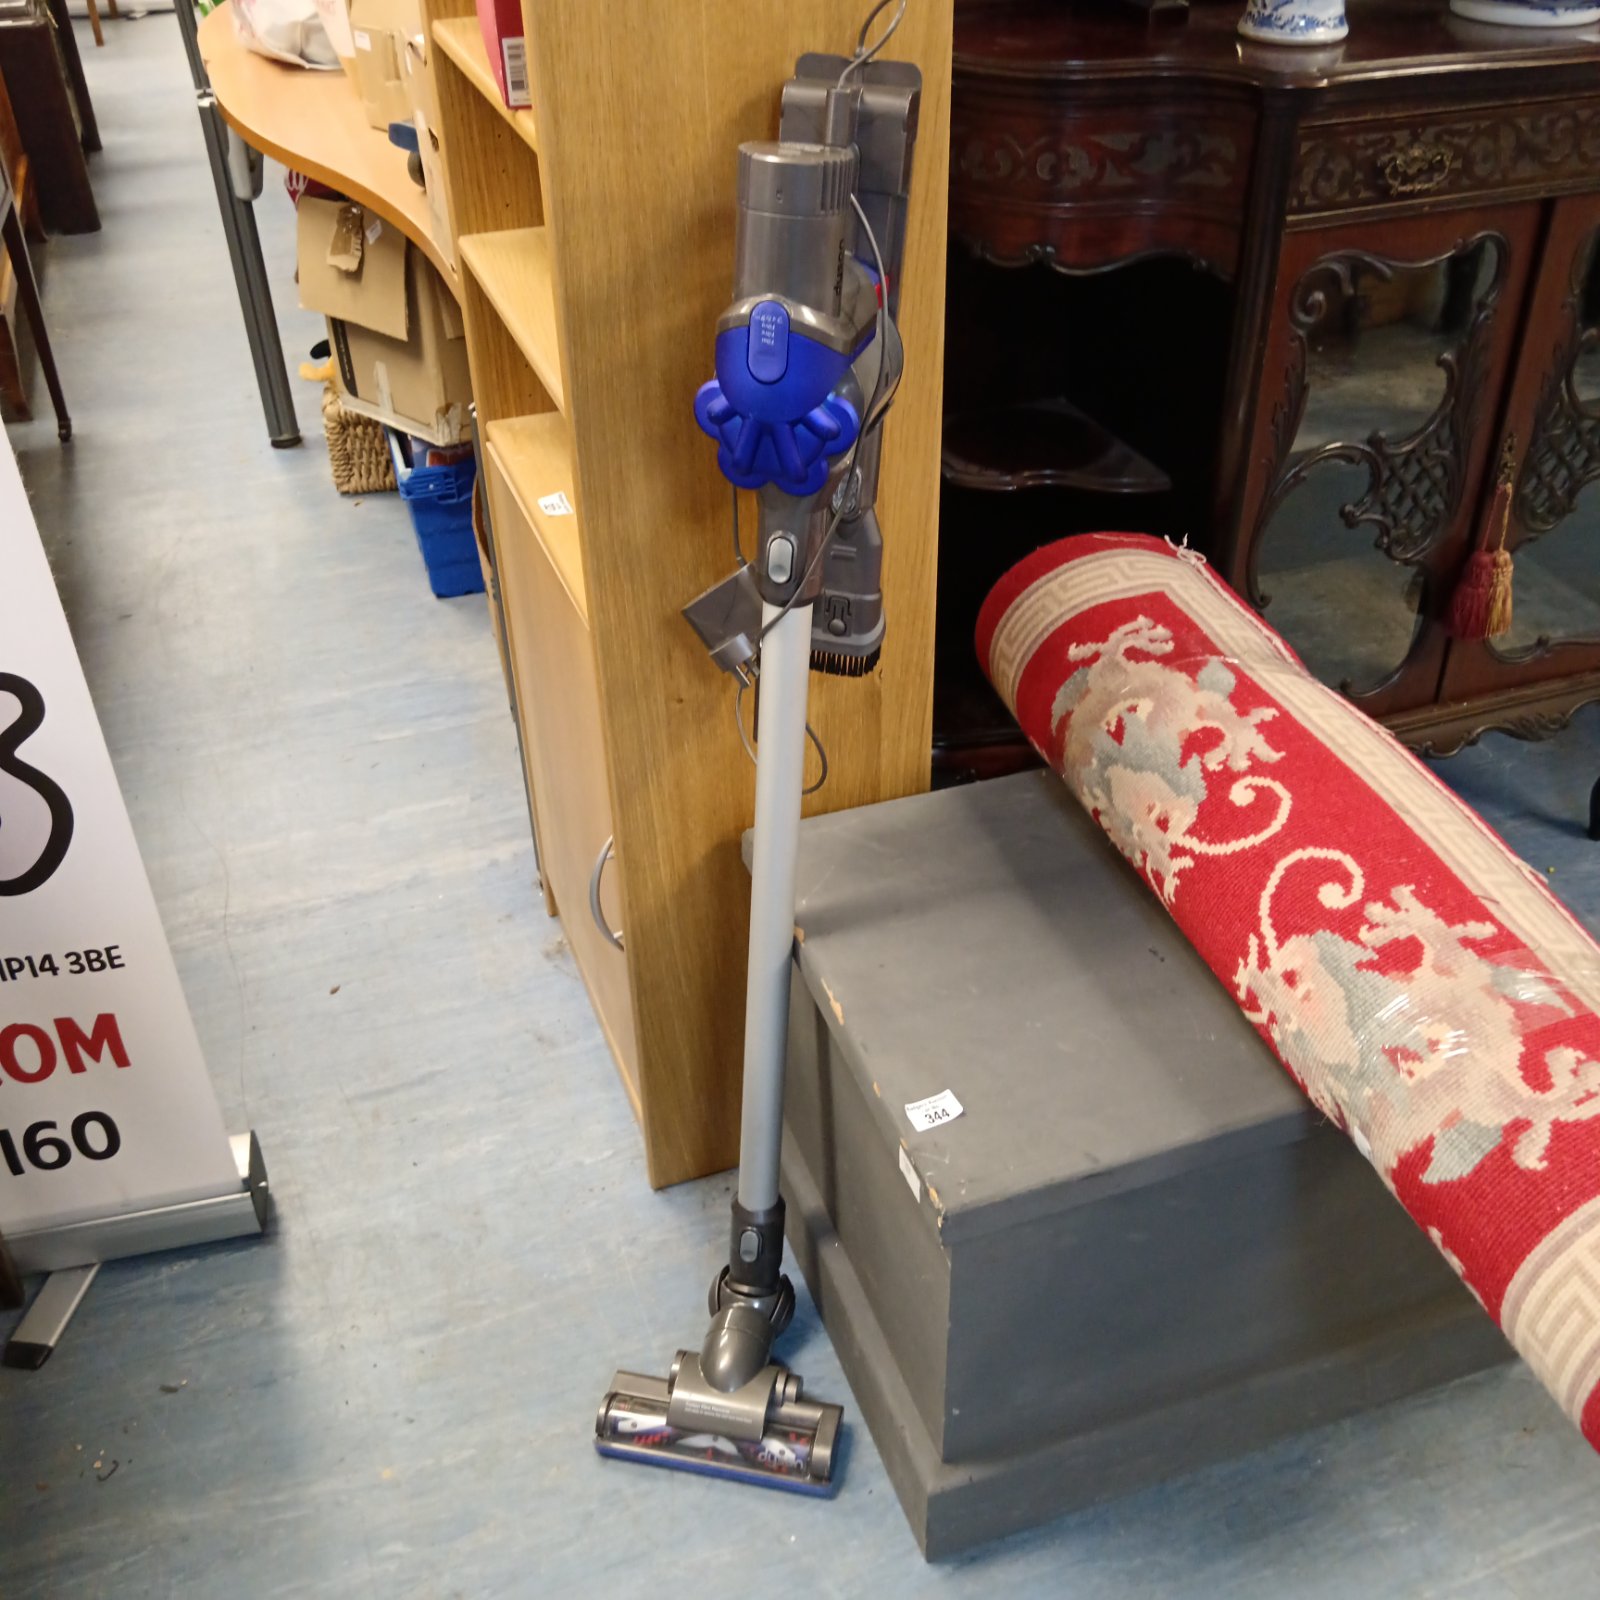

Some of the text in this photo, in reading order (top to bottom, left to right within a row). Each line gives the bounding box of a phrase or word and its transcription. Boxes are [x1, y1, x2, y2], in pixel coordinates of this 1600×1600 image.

[64, 945, 125, 974] 3BE
[0, 1013, 131, 1086] OM
[925, 1108, 950, 1123] 344
